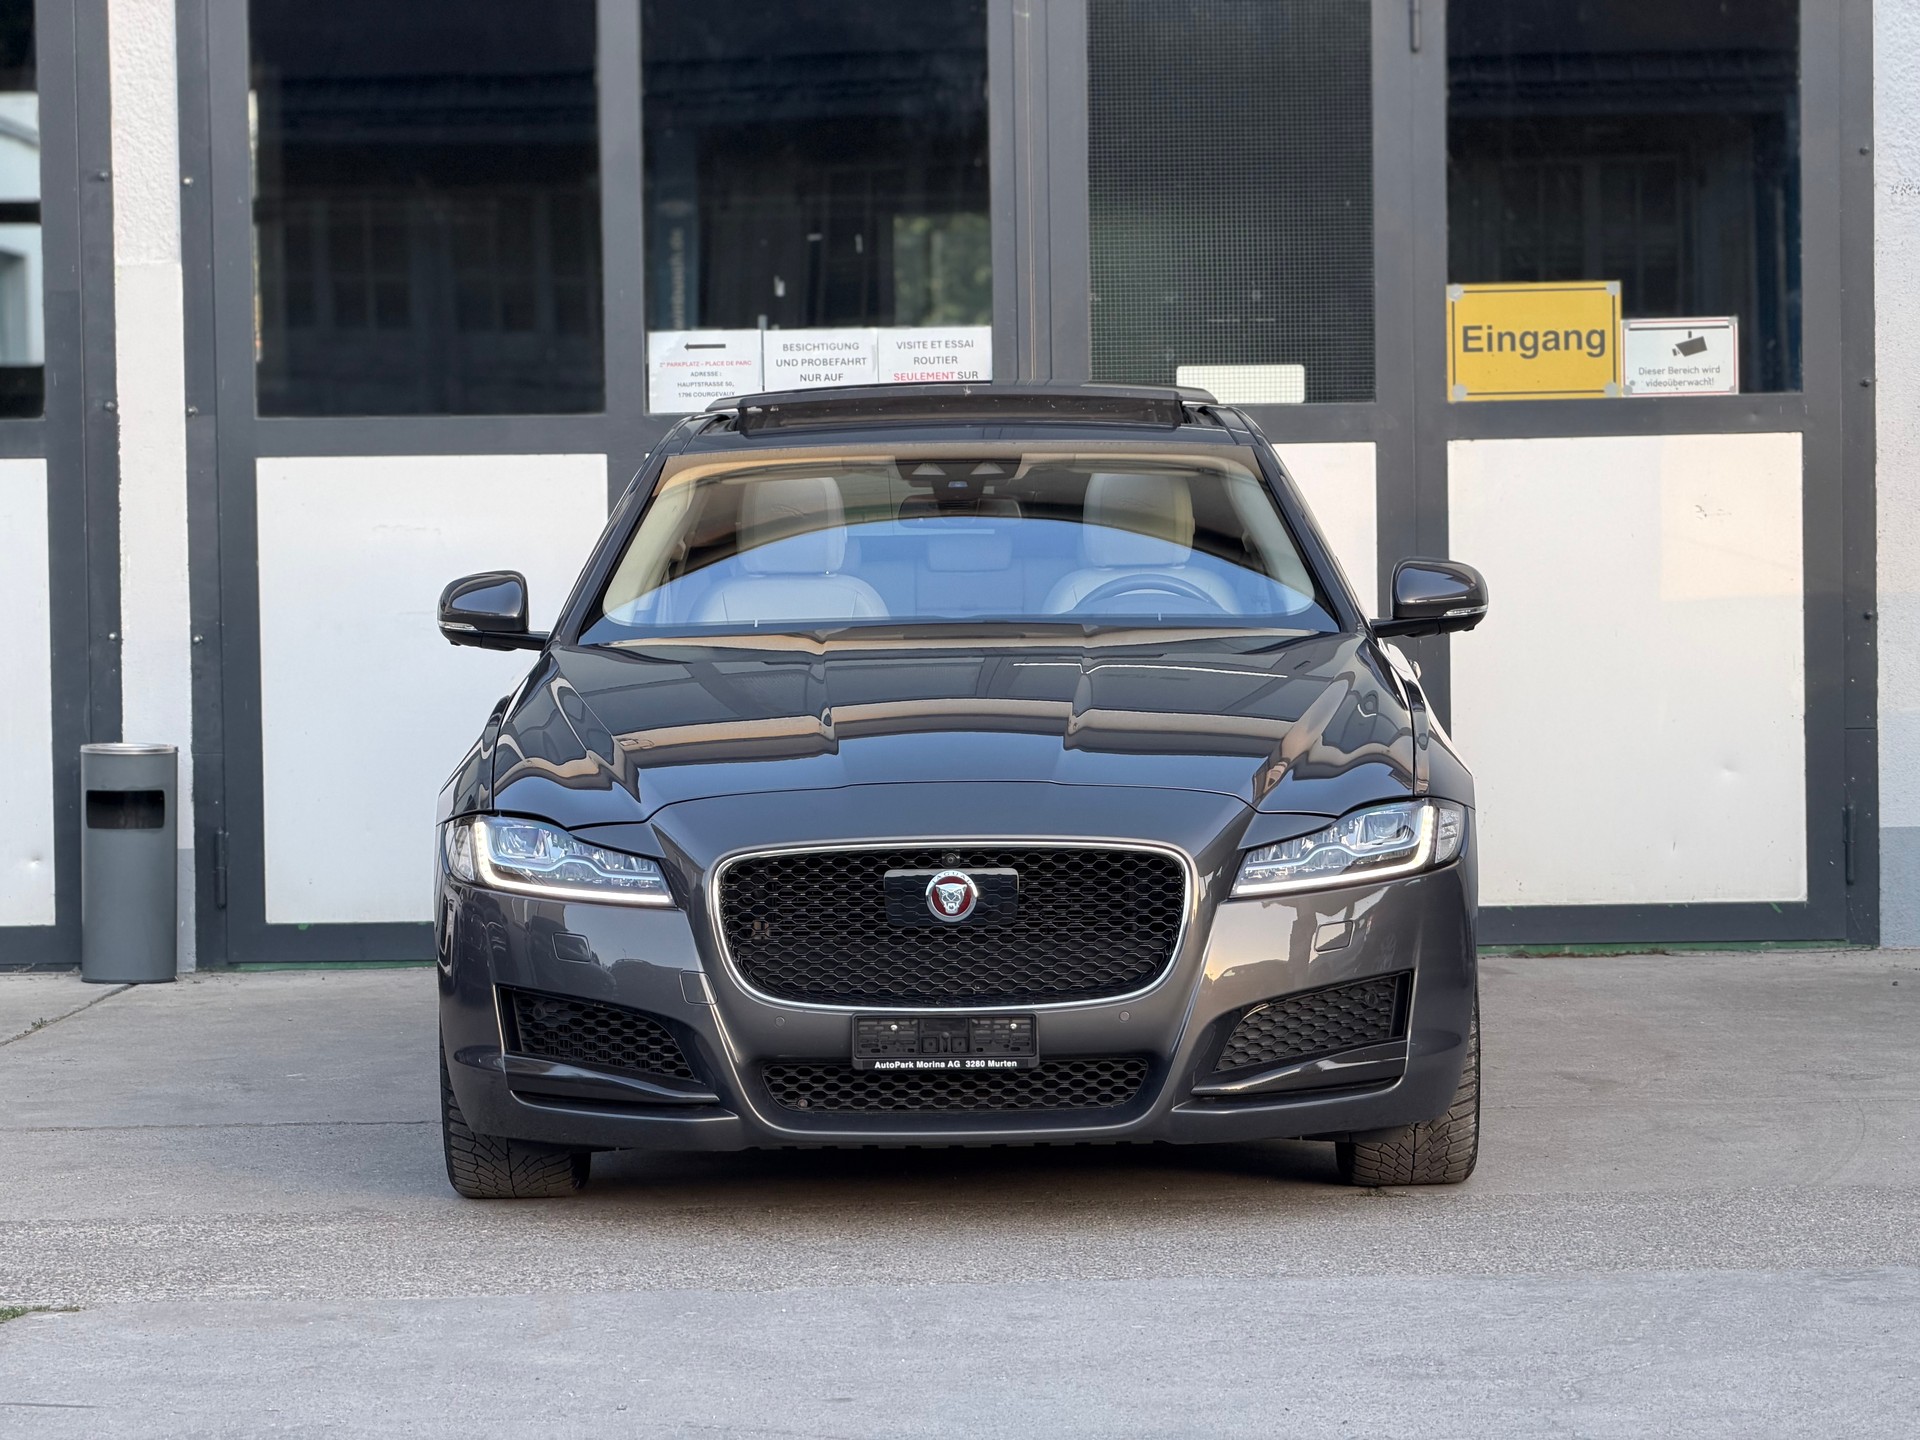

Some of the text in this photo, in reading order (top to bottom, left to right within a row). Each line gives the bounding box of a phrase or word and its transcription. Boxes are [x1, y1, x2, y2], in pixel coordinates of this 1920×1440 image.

[896, 339, 975, 350] VISITE ET ESSAI
[1462, 324, 1606, 359] Eingang
[782, 342, 860, 352] BESICHTIGUNG
[666, 360, 700, 368] PARKPLATZ
[775, 357, 867, 367] UND PROBEFAHRT
[913, 356, 959, 365] ROUTIER
[1638, 364, 1721, 376] Dieser Bereich wird
[799, 373, 844, 382] NUR AUF
[893, 371, 979, 381] SEULEMENT SUR
[1645, 376, 1715, 388] videoüberwacht!
[874, 1059, 1018, 1070] AutoPark Morina AG 3280 Murten
